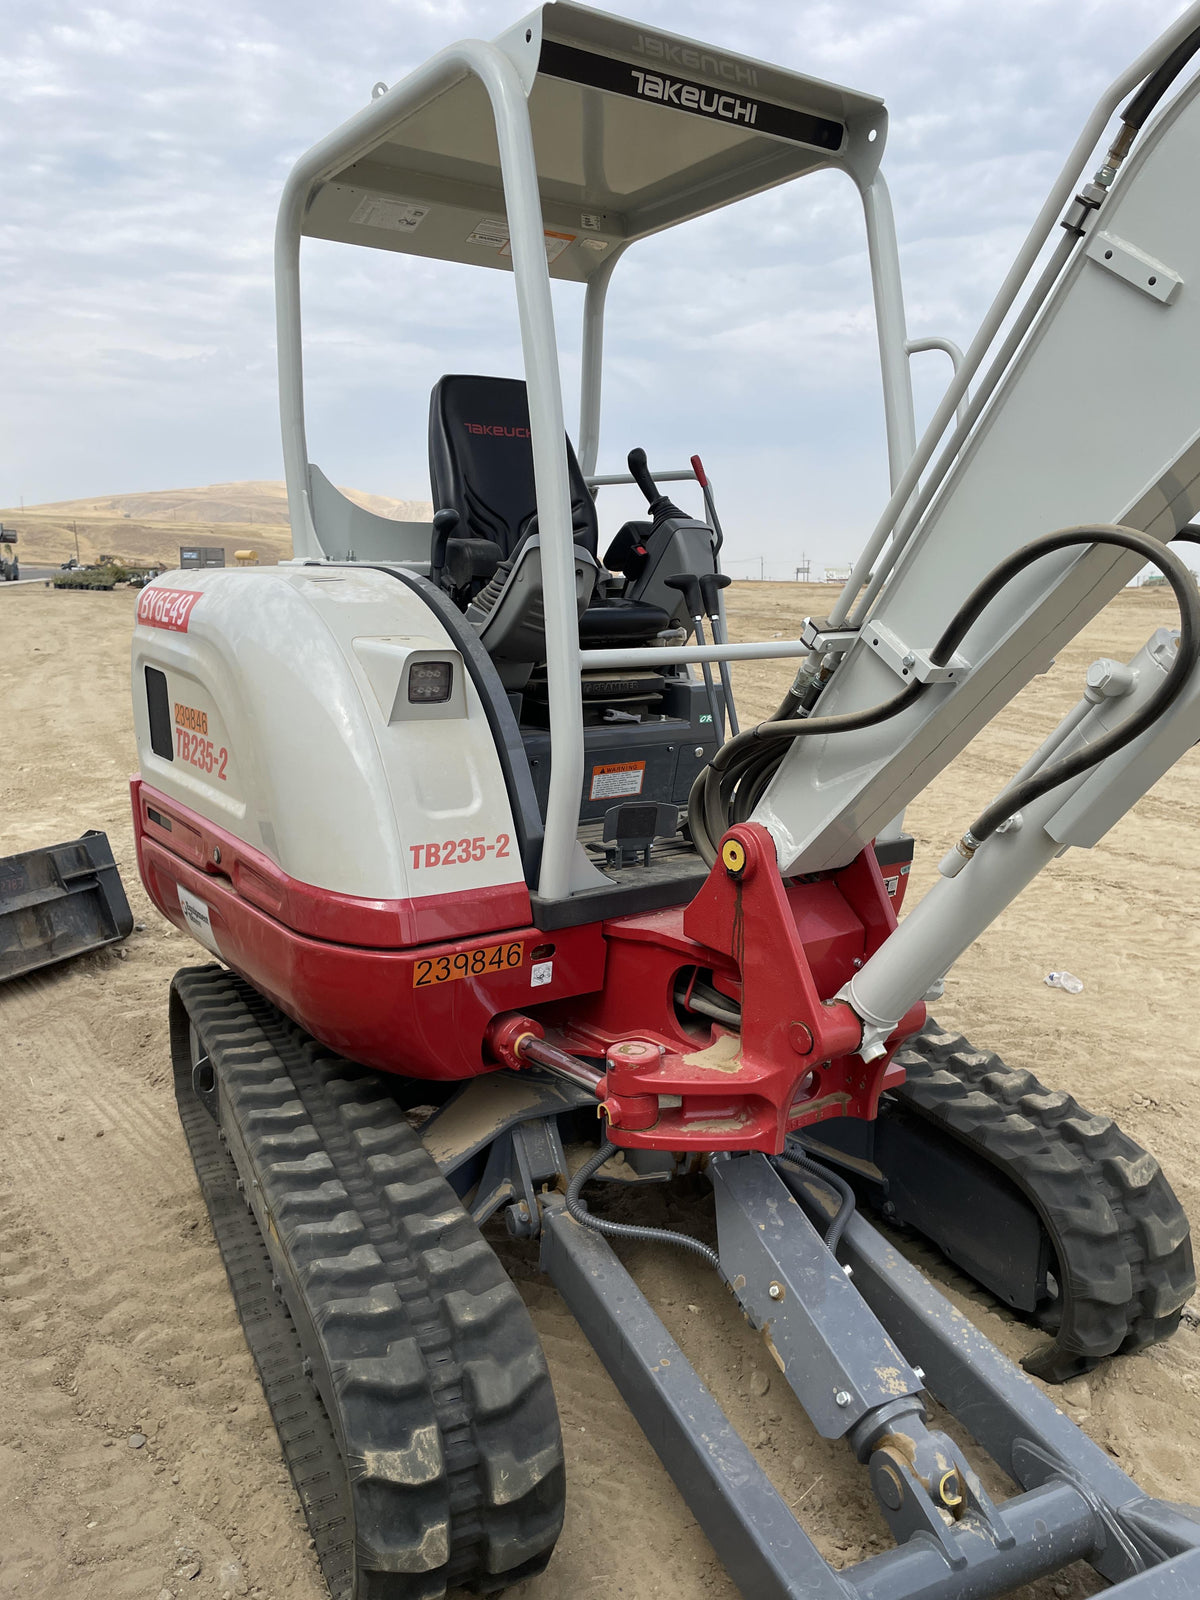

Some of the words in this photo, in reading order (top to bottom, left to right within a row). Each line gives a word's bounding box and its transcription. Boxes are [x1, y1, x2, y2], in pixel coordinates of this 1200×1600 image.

[464, 422, 531, 438] TAKEUCH
[140, 589, 194, 626] BY6E49
[174, 703, 208, 735] 239846
[175, 727, 229, 781] TB235-2
[606, 764, 638, 773] WARNING
[409, 833, 510, 870] TB235-2
[415, 943, 522, 987] 239846
